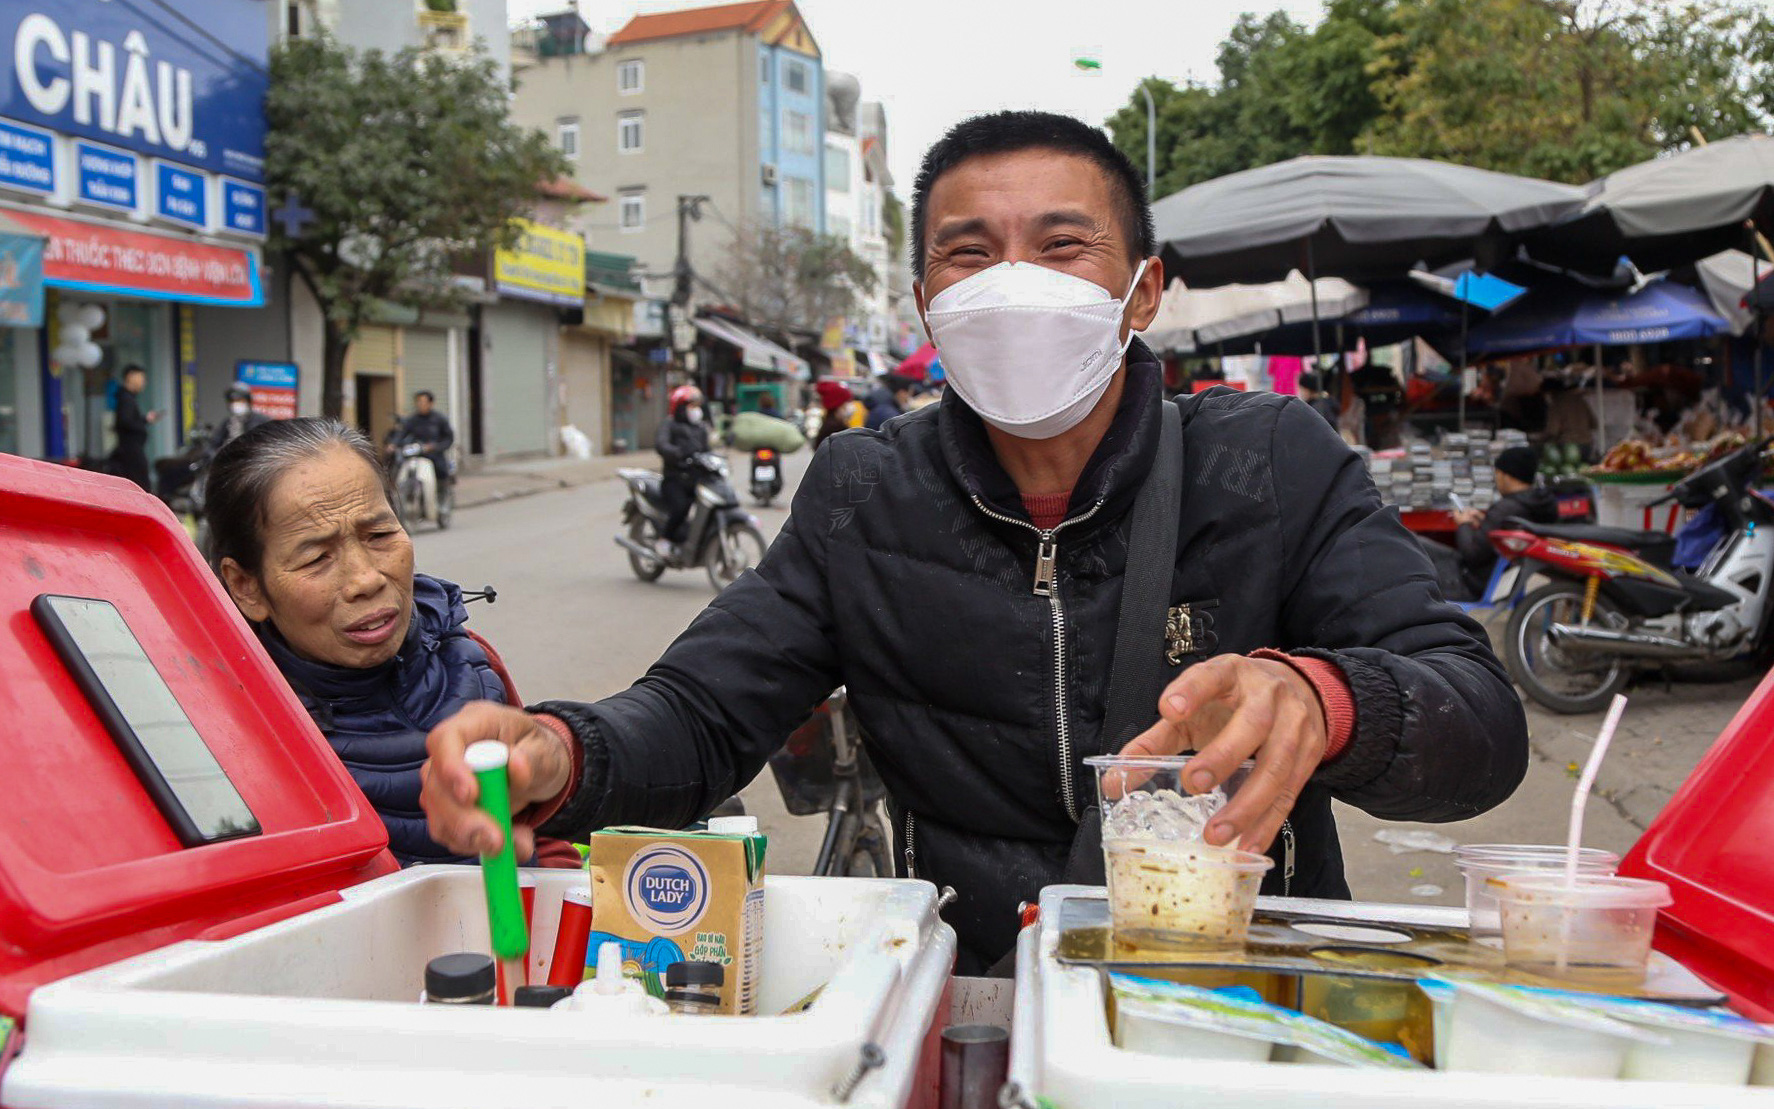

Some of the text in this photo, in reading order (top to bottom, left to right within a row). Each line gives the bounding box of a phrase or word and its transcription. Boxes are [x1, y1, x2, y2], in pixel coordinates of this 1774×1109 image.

[15, 13, 192, 150] CHÂU
[646, 876, 689, 891] DUTCH
[651, 890, 684, 903] LADY
[694, 944, 708, 957] GÓP
